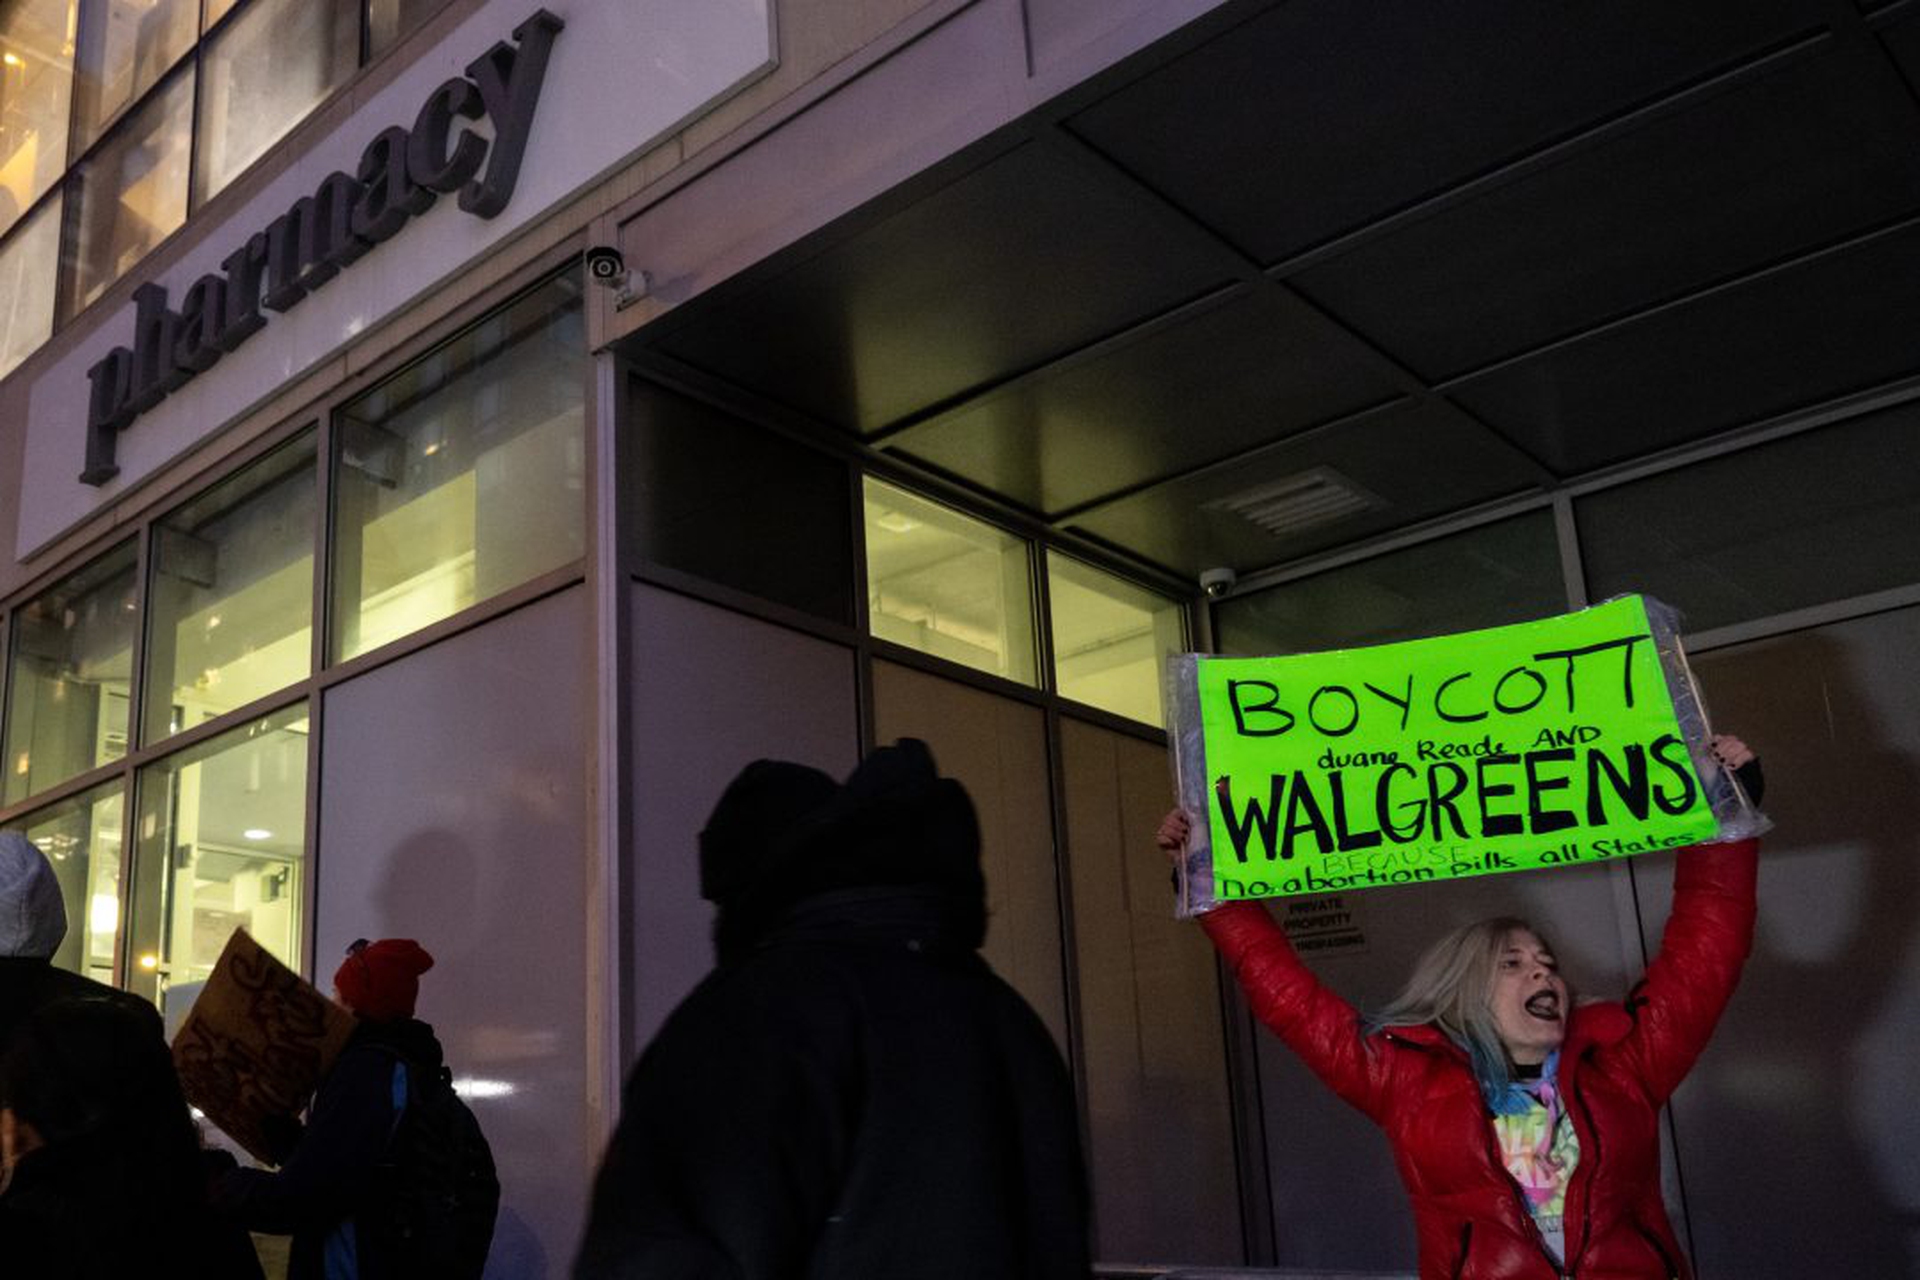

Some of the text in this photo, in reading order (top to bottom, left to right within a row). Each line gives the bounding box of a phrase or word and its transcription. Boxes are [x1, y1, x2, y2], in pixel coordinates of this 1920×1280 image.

[79, 8, 565, 487] pharmacy
[1227, 634, 1652, 737] BOYCOTT
[1532, 724, 1601, 748] AND
[1215, 733, 1698, 864] WALGREENS
[1283, 866, 1434, 893] abortion
[1539, 844, 1580, 865] all
[1323, 844, 1468, 875] BECAUSE
[1283, 913, 1352, 931] PROPERTY
